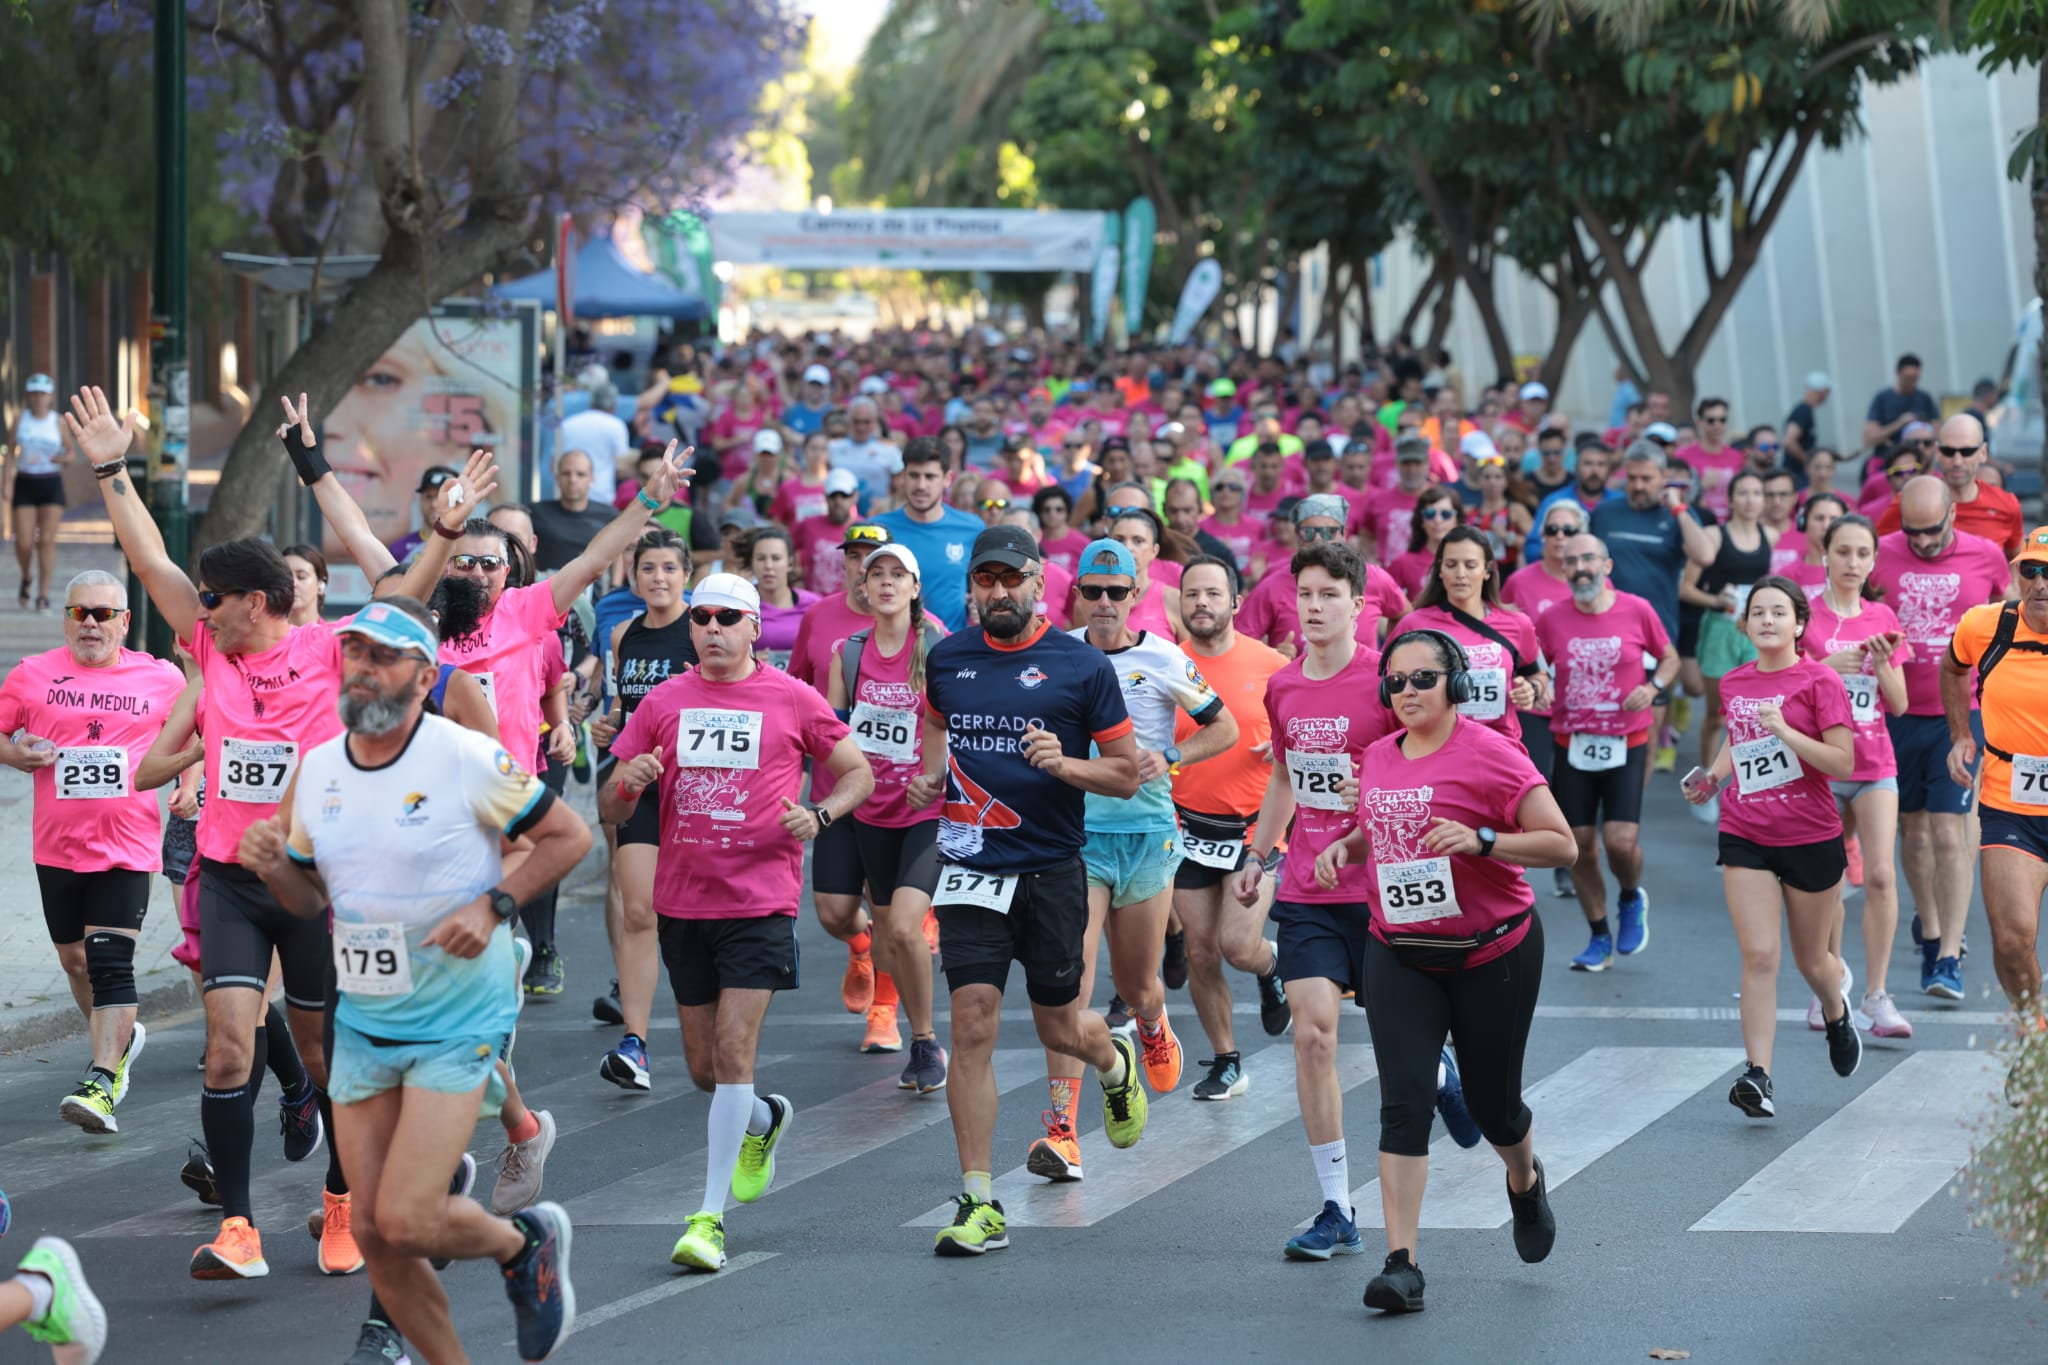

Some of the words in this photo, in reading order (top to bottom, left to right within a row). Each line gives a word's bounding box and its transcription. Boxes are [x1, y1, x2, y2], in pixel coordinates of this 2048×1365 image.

[46, 688, 85, 708] DONA
[856, 720, 908, 745] 450
[950, 713, 1045, 732] CERRADO
[688, 729, 750, 752] 715
[1583, 744, 1612, 761] 43
[64, 764, 120, 785] 239
[227, 760, 288, 787] 387
[1740, 751, 1789, 780] 721
[1293, 769, 1344, 793] 728
[2021, 772, 2048, 792] 70
[1184, 836, 1235, 858] 230
[945, 873, 1004, 896] 571
[1386, 880, 1446, 908] 353
[341, 948, 397, 975] 179
